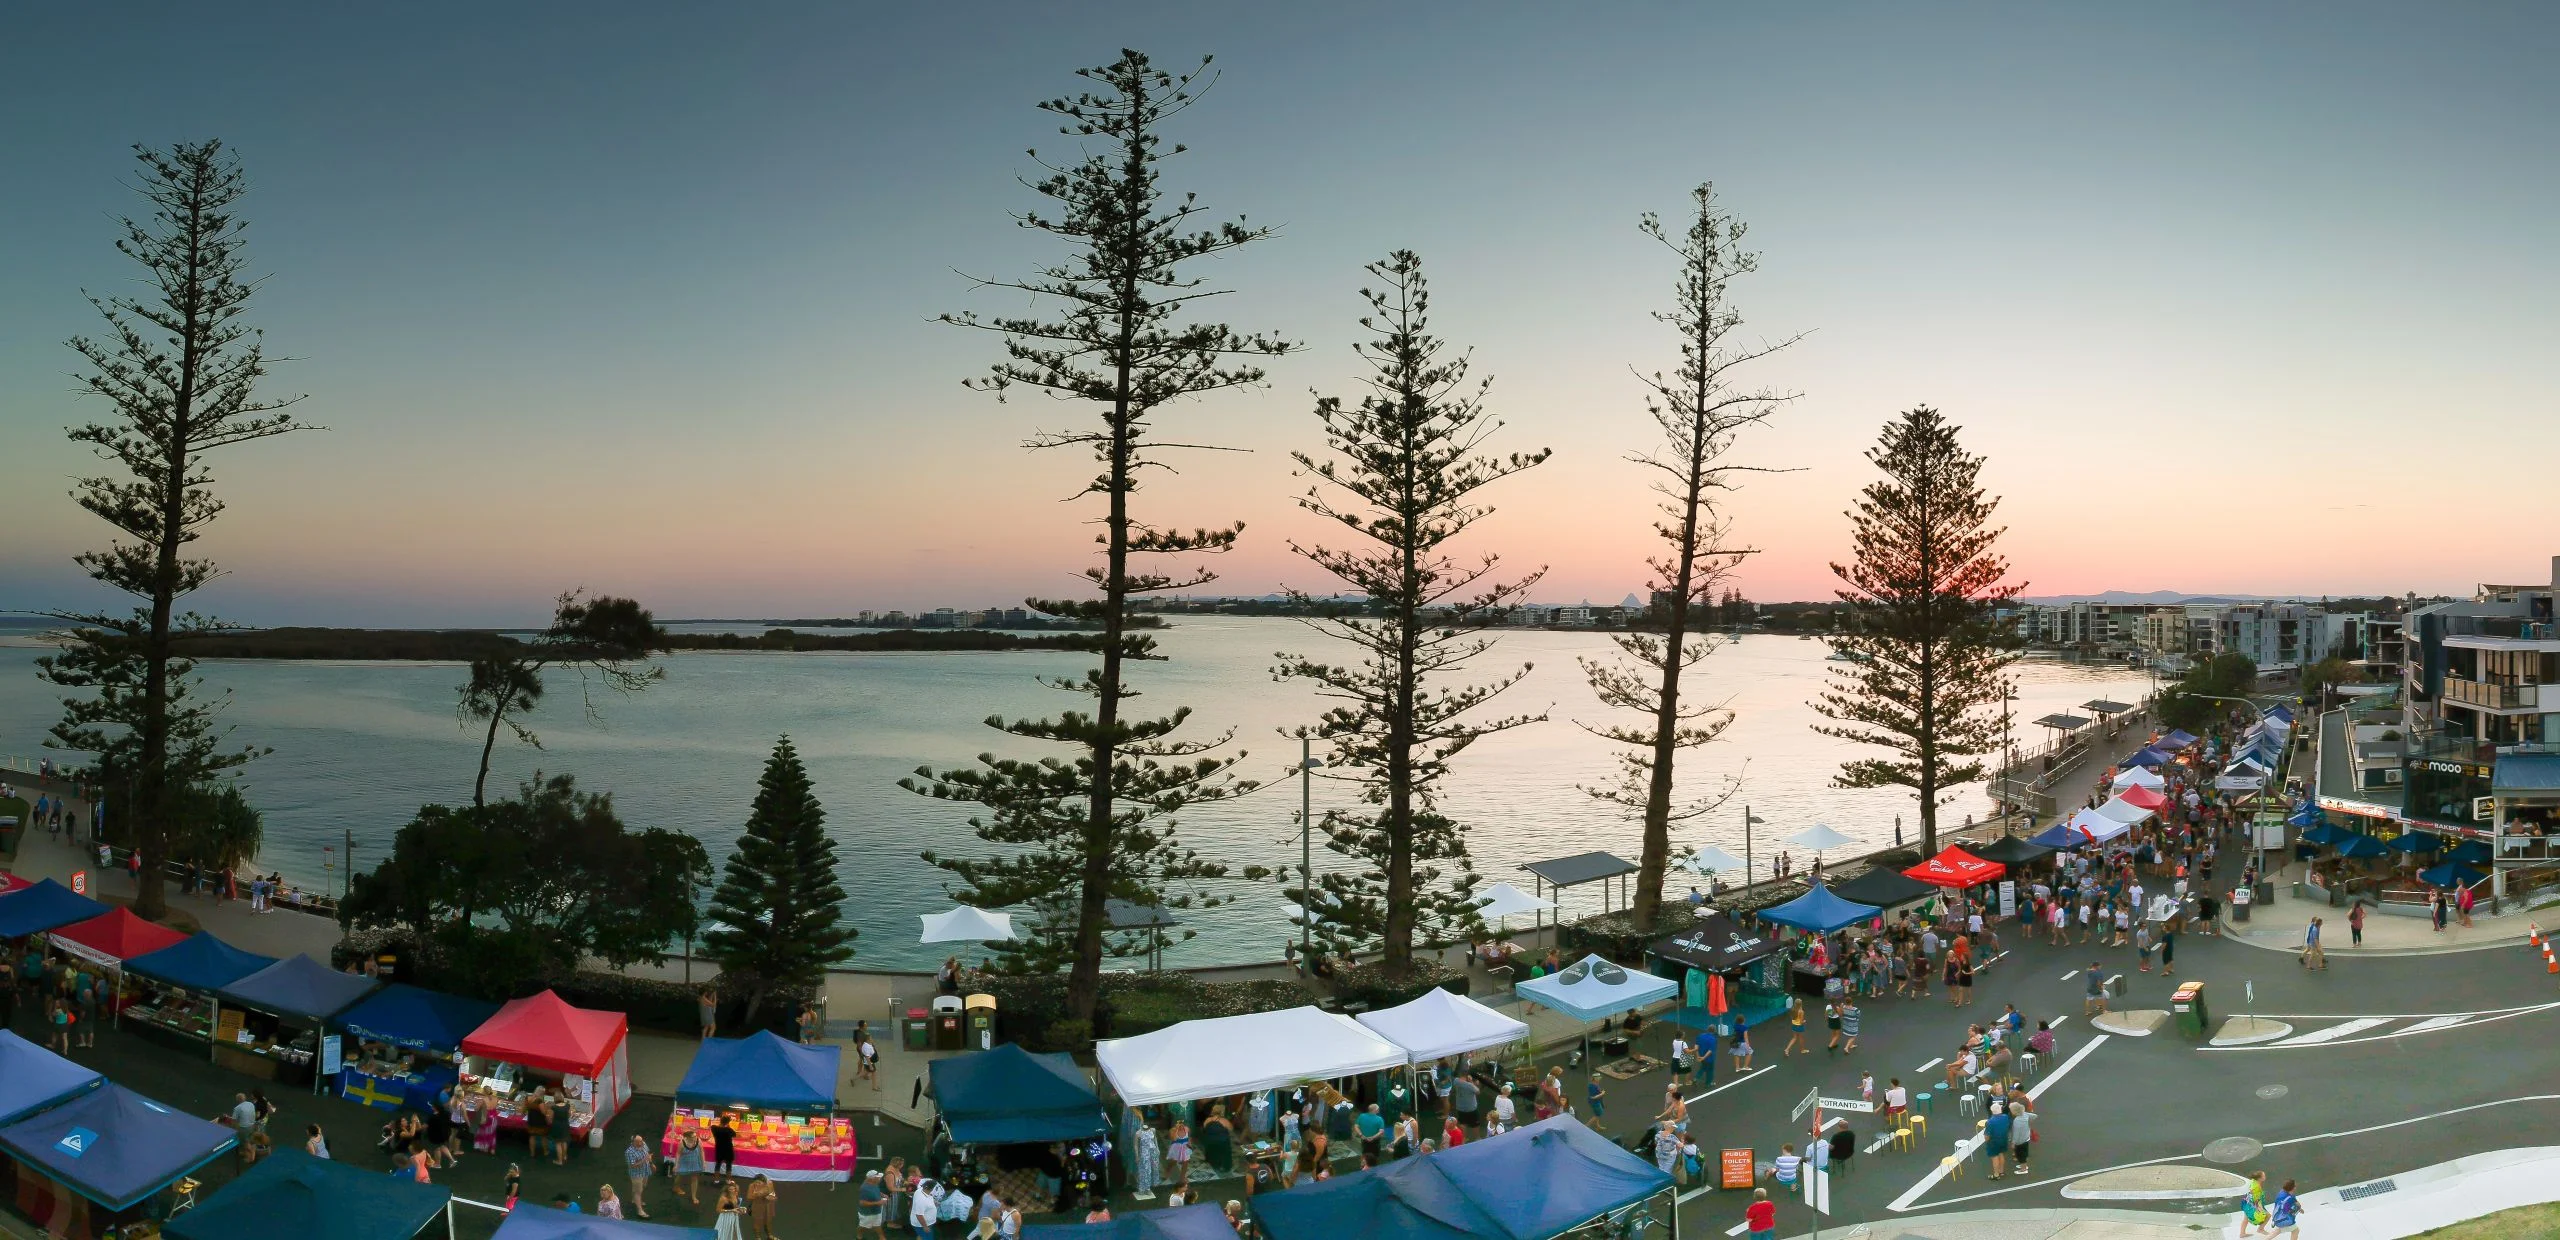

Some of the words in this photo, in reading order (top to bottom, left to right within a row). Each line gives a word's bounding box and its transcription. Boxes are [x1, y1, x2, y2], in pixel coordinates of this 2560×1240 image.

[2429, 761, 2461, 773] mooo
[2434, 823, 2461, 831] BAKERY
[1824, 1100, 1858, 1109] OTRANTO
